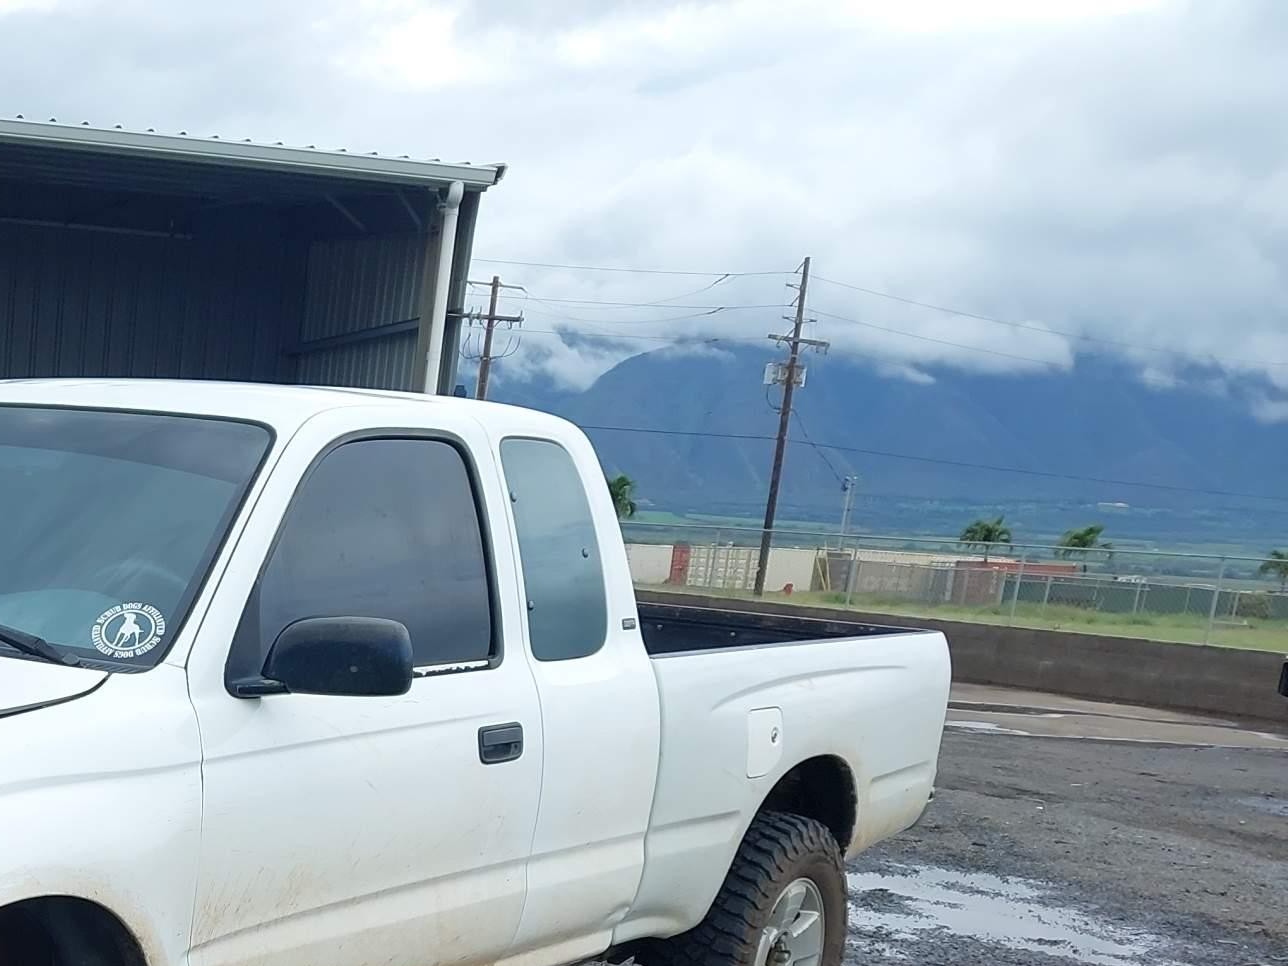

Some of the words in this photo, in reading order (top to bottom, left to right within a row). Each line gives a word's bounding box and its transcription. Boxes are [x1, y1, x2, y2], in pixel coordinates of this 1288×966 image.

[96, 605, 122, 624] SCRUB
[122, 602, 143, 610] DOGS
[113, 650, 134, 658] DOGS
[135, 636, 161, 656] SCRUB
